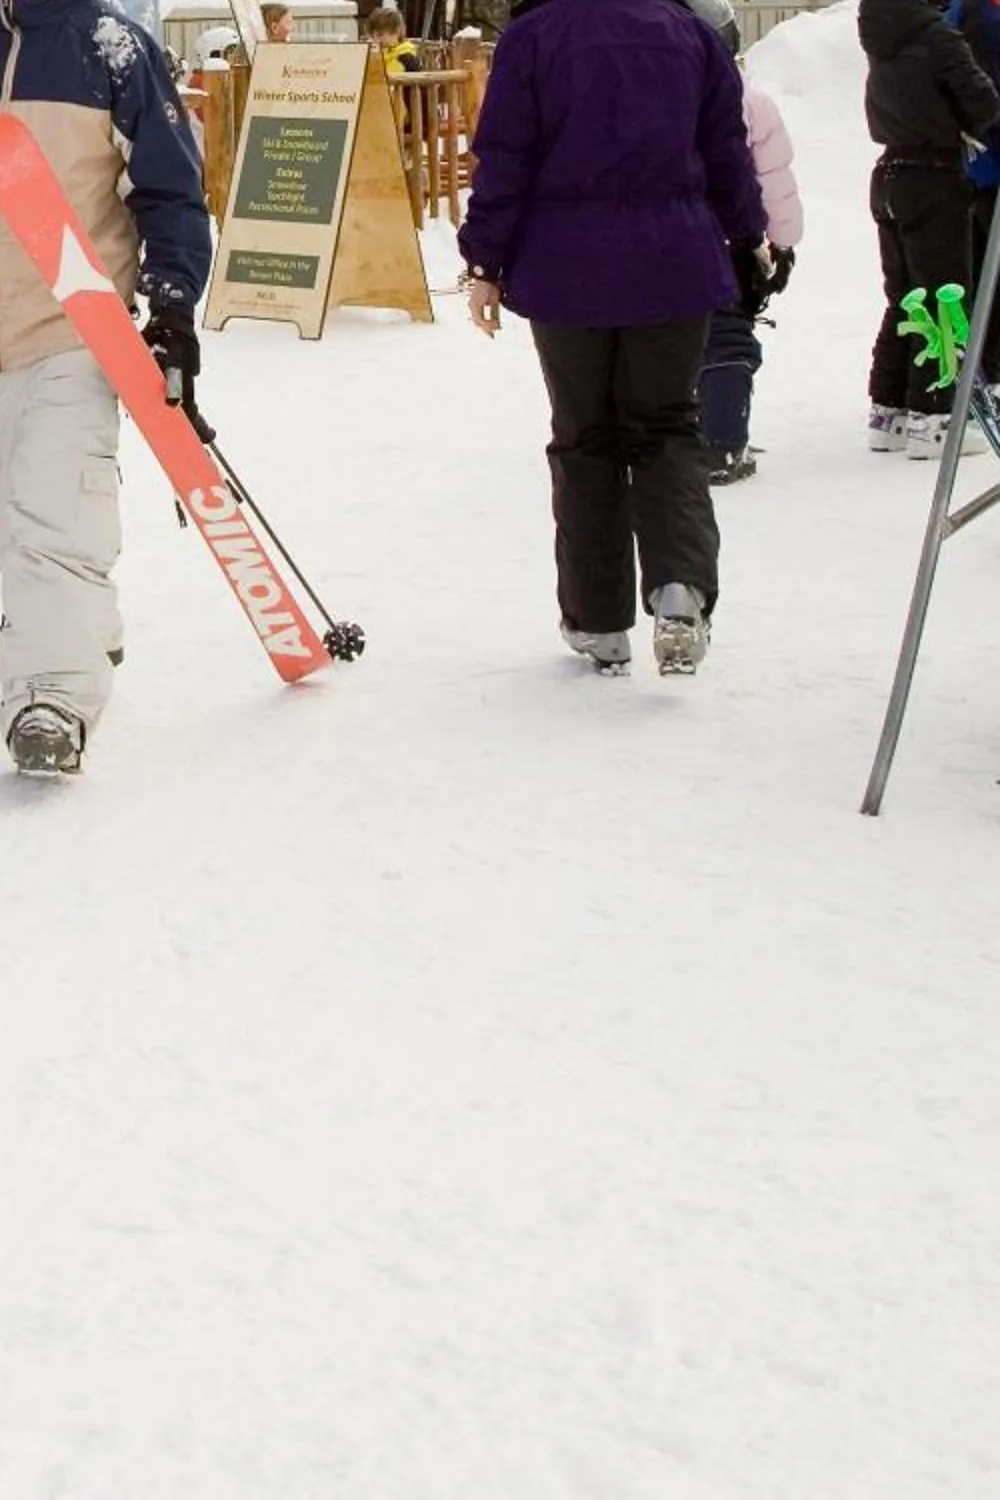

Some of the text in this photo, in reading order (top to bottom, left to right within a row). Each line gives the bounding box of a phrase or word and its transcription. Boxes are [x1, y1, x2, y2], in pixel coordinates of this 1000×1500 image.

[253, 89, 357, 104] Winter Sports School
[189, 484, 313, 658] ATOMIC
